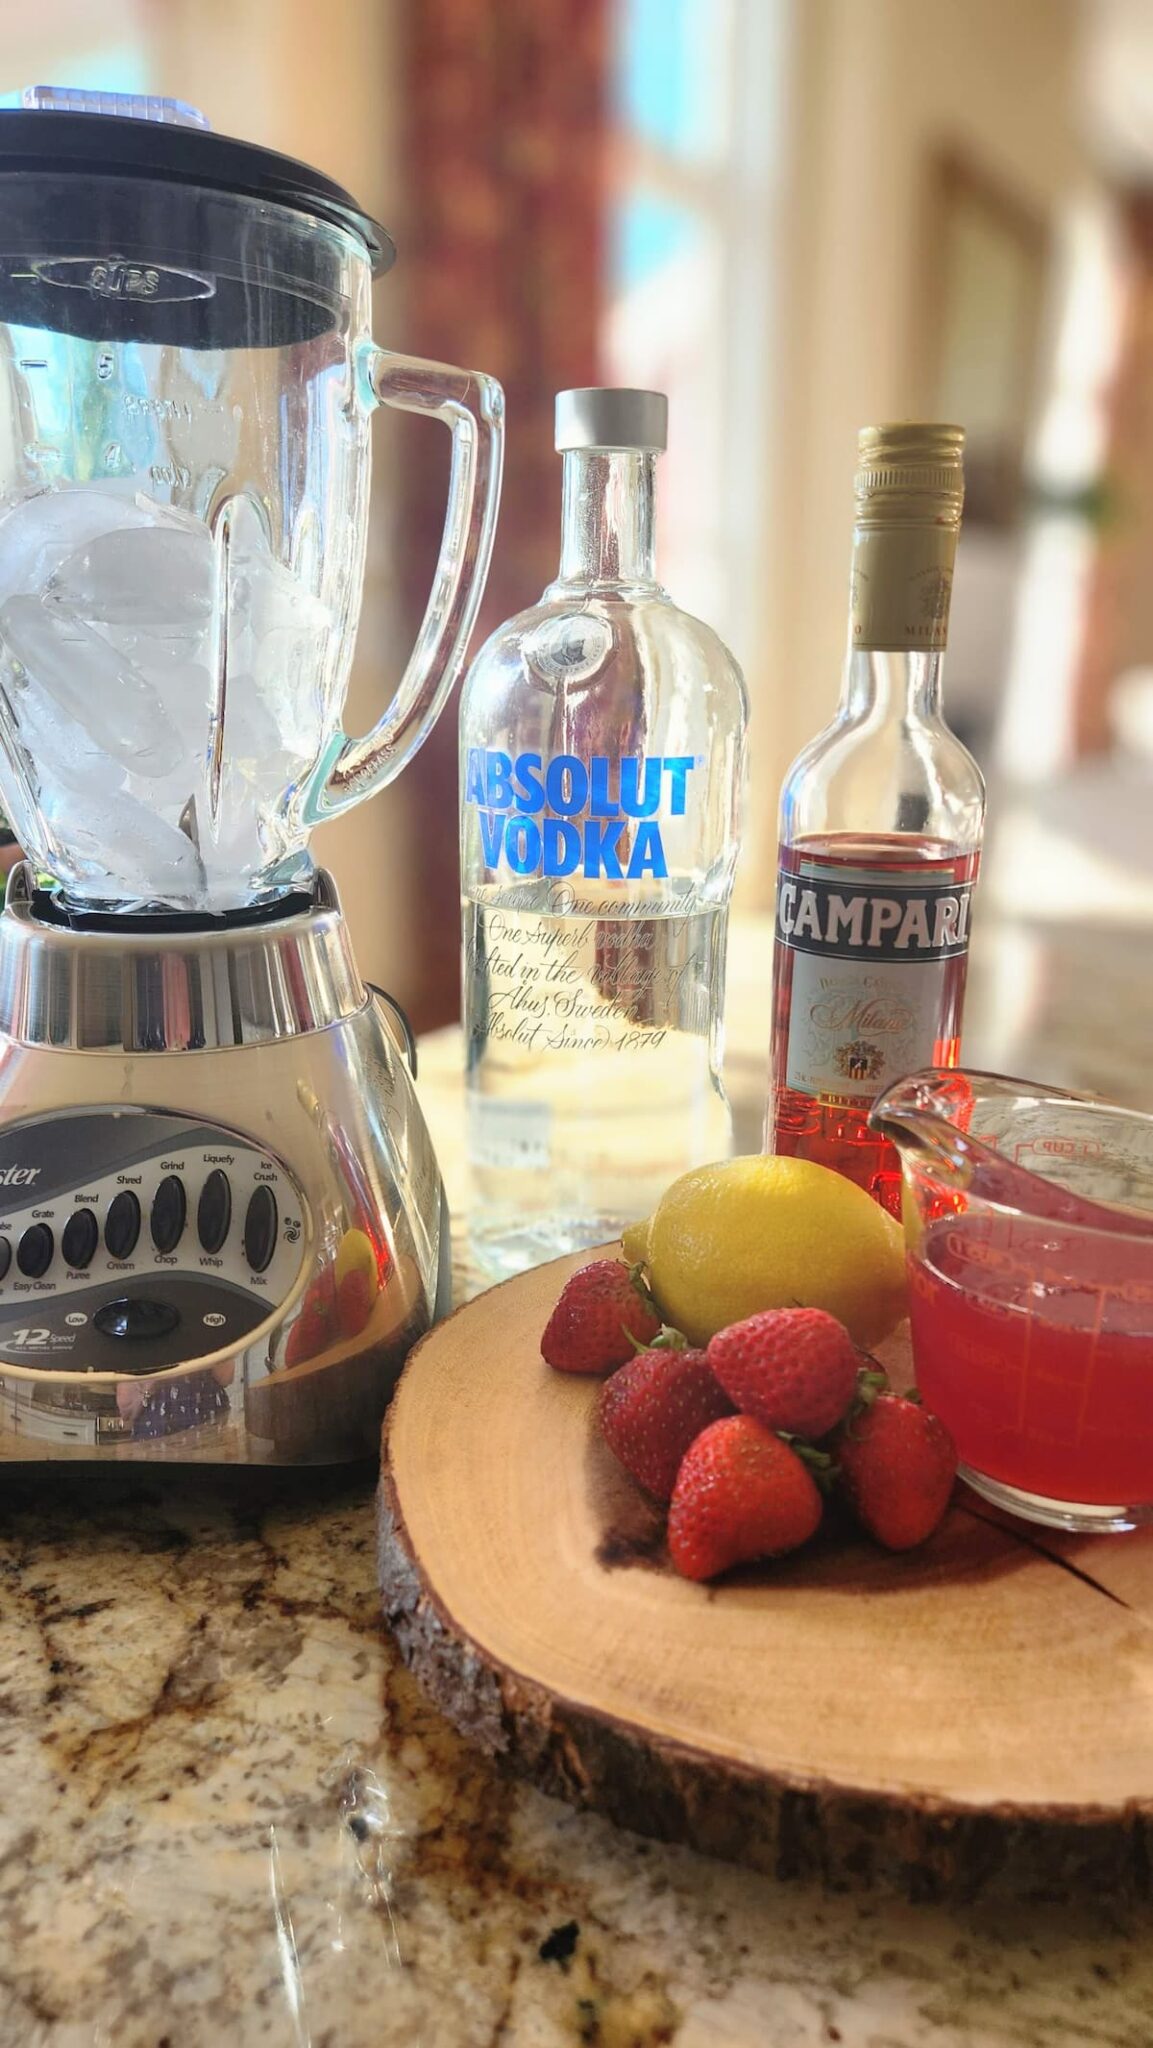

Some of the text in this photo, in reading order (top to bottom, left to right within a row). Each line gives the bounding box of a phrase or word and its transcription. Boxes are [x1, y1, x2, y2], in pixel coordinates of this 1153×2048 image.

[465, 747, 695, 818] ABSOLUT
[477, 809, 669, 879] VODKA
[547, 880, 594, 918] One
[779, 883, 970, 949] CAMPARI
[478, 908, 522, 943] One
[519, 962, 541, 980] in
[540, 950, 584, 984] the
[612, 1029, 667, 1052] 1879
[203, 1154, 235, 1165] Liquefy
[160, 1161, 185, 1171] Grind
[260, 1161, 272, 1170] Ice
[116, 1175, 142, 1185] Shred
[253, 1172, 278, 1182] Crush
[74, 1194, 99, 1203] Blend
[31, 1209, 55, 1219] Grate
[154, 1254, 178, 1266] Chop
[199, 1257, 223, 1268] Whip
[106, 1261, 135, 1271] Cream
[66, 1271, 91, 1281] Puree
[250, 1276, 267, 1286] Mix
[13, 1281, 32, 1293] Easy
[33, 1281, 57, 1291] Clean
[67, 1315, 86, 1324] Low
[205, 1315, 225, 1326] High
[13, 1328, 51, 1345] 12
